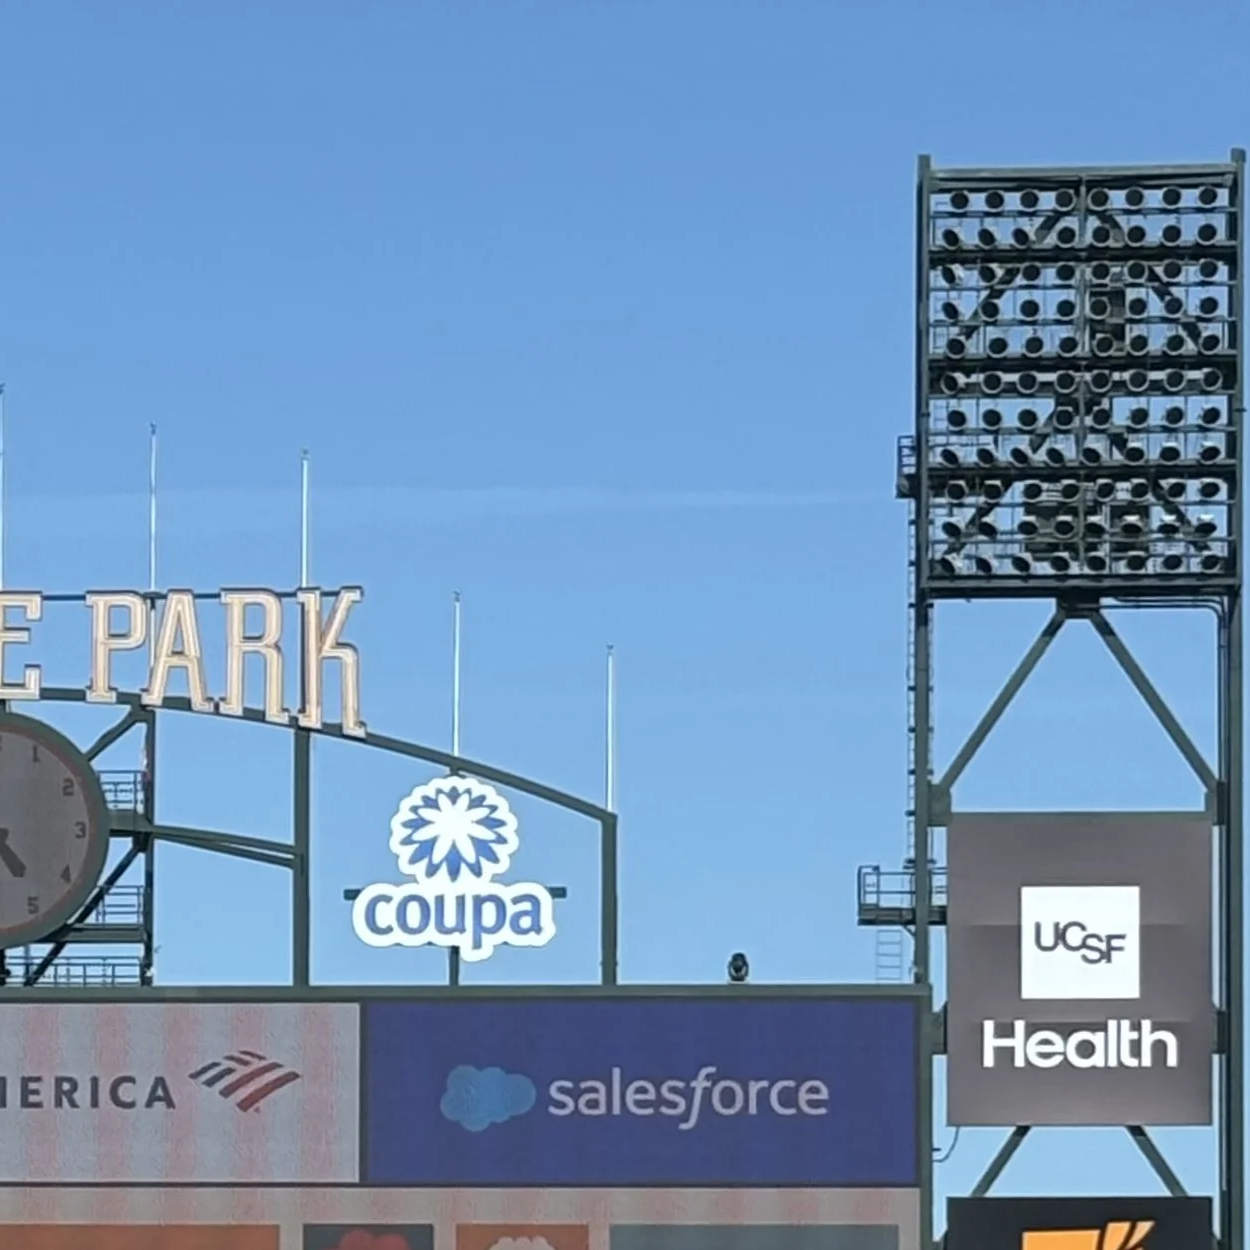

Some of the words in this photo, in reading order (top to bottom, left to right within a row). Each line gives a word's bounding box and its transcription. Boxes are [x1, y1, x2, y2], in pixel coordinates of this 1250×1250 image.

[85, 585, 367, 739] PARK
[31, 745, 40, 762] 1
[63, 779, 75, 796] 2
[75, 822, 86, 839] 3
[60, 865, 71, 883] 4
[27, 897, 39, 914] 5
[364, 892, 543, 949] coupa
[1034, 921, 1126, 964] UCSF
[982, 1020, 1177, 1068] Health
[547, 1066, 830, 1130] salesforce
